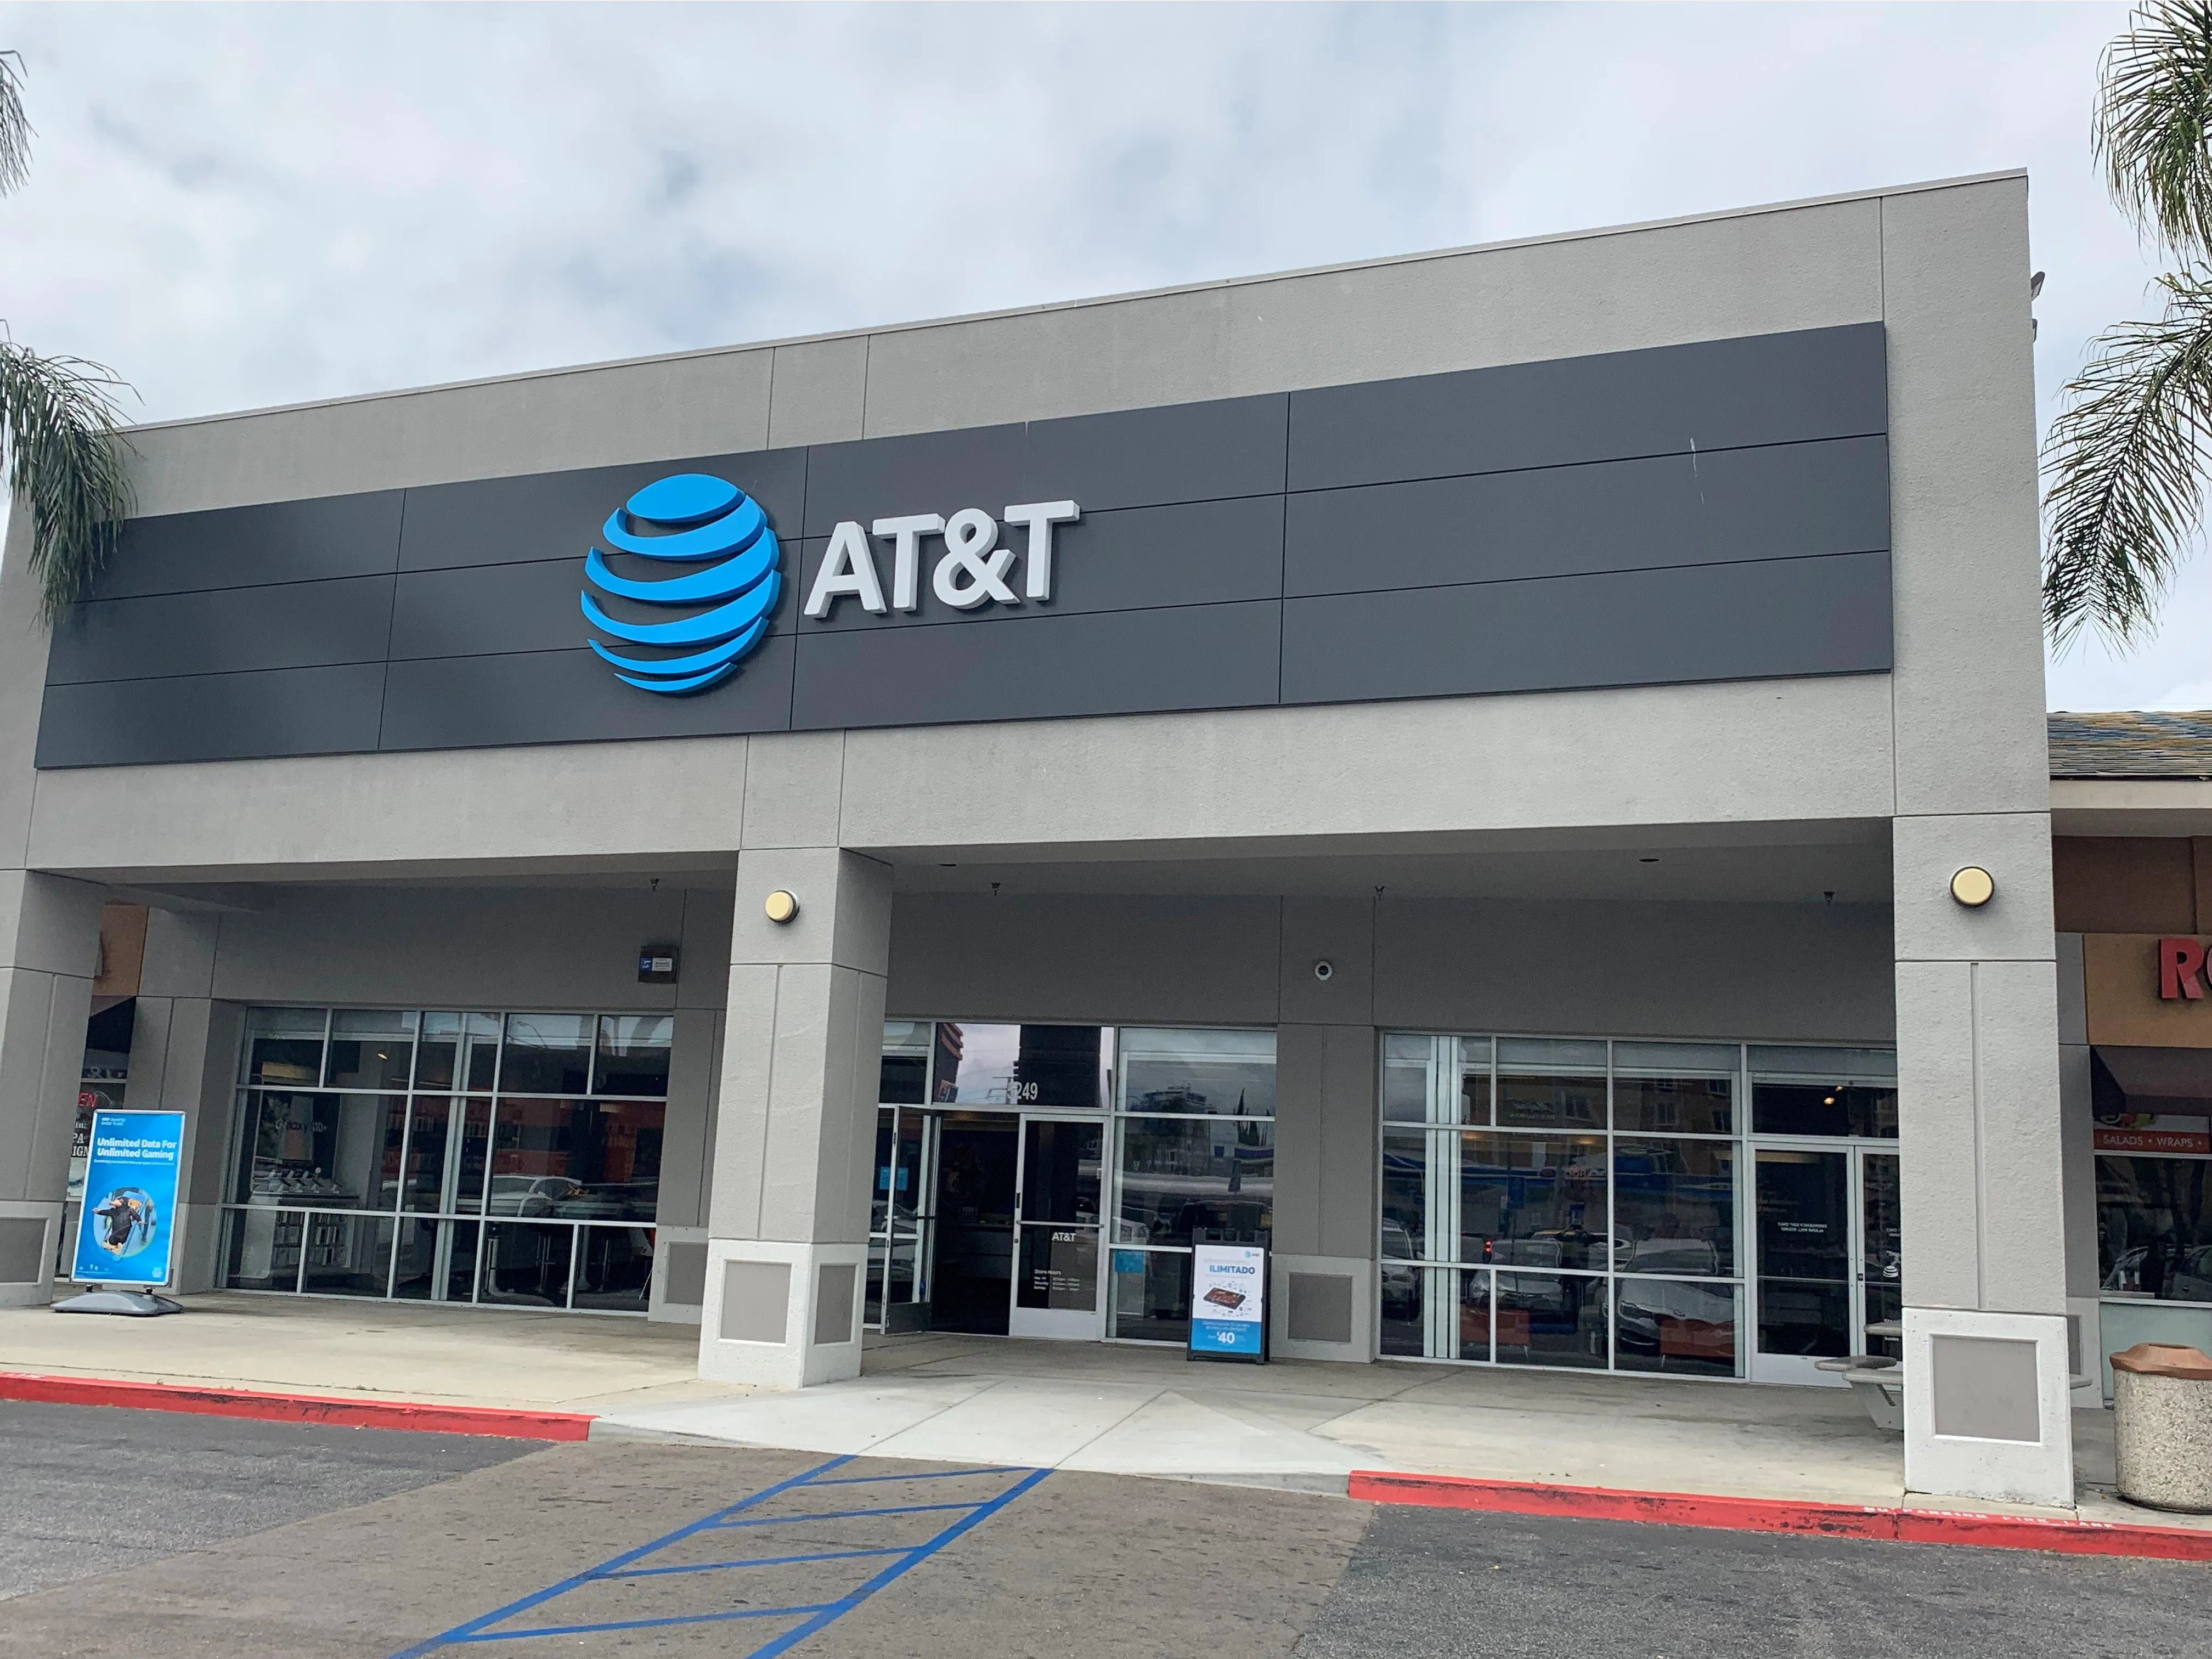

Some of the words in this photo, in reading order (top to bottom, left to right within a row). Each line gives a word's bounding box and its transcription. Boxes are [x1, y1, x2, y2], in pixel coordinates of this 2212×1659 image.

[804, 500, 1080, 618] AT&T
[2159, 938, 2212, 999] R
[275, 1119, 308, 1134] Galaxy
[97, 1137, 140, 1148] Unlimited
[141, 1139, 161, 1148] Data
[162, 1139, 177, 1149] For
[2103, 1135, 2143, 1146] SALADS
[2157, 1137, 2193, 1147] WRAPS
[97, 1148, 141, 1158] Unlimited
[142, 1149, 174, 1161] Gaming
[1052, 1232, 1077, 1242] AT&T
[1209, 1265, 1256, 1274] ILIMITADO
